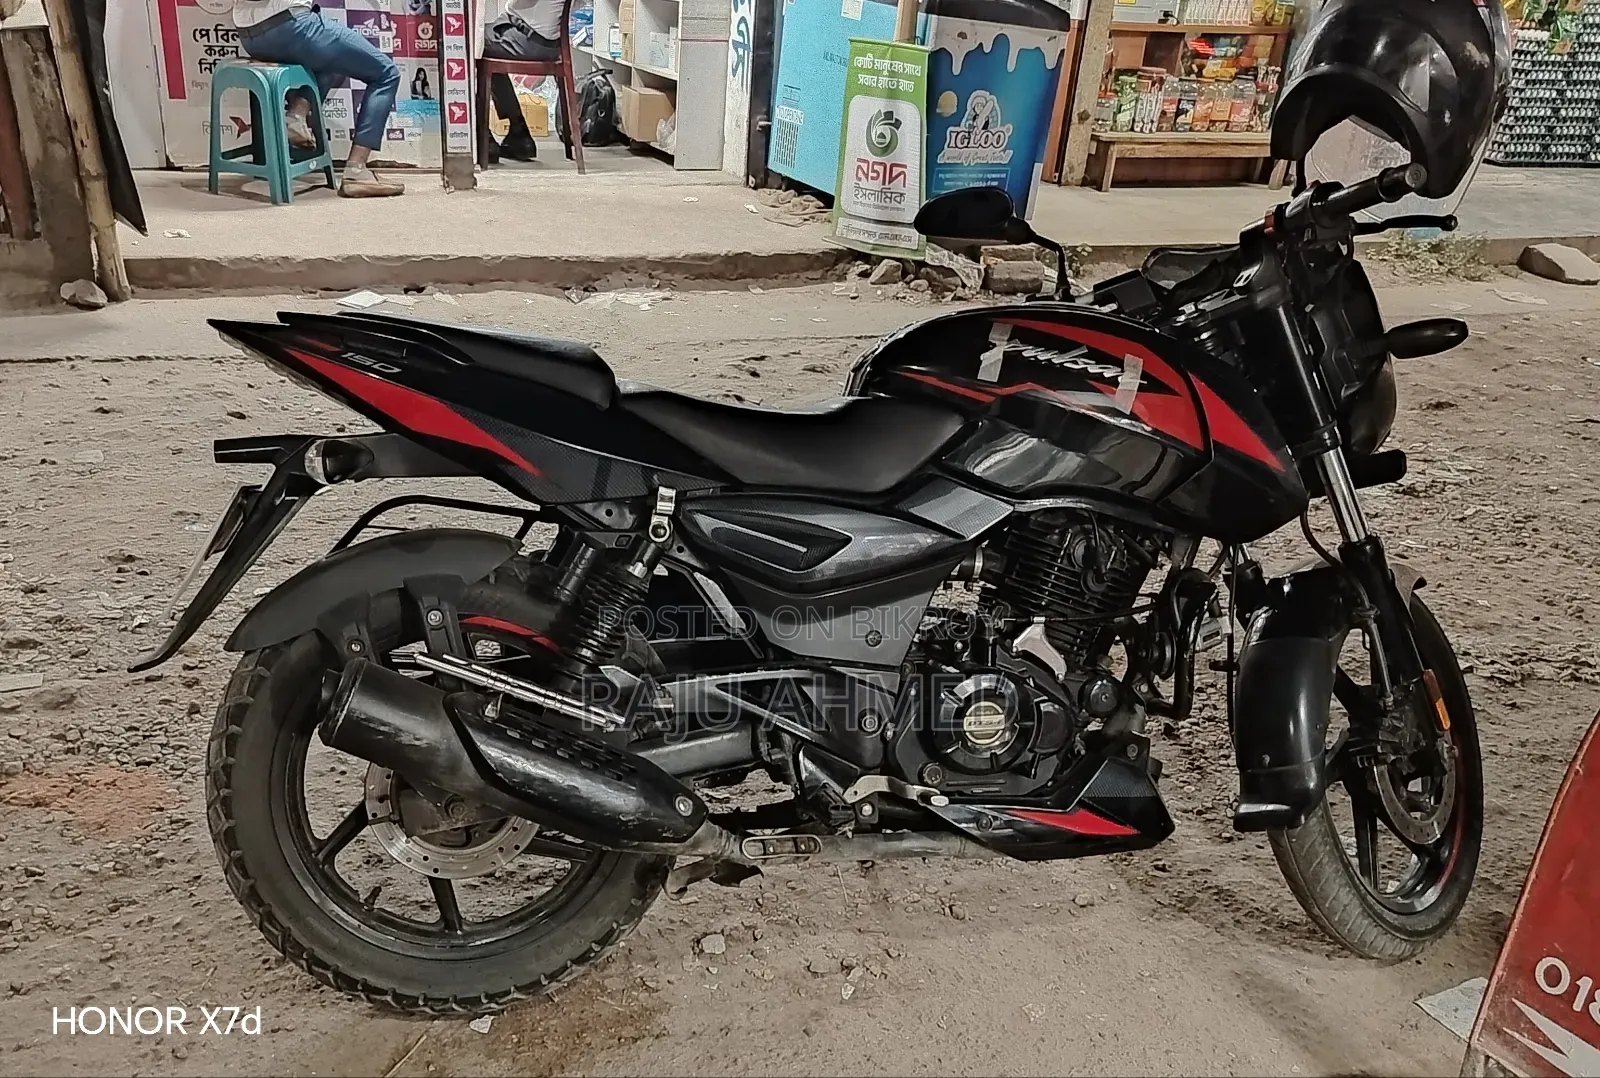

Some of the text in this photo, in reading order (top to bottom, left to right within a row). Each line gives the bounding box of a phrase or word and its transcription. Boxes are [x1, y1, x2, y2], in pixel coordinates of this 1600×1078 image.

[193, 29, 211, 42] পে
[415, 39, 437, 50] নগদ
[203, 45, 239, 58] করুন
[854, 53, 873, 69] কোটি
[874, 59, 903, 75] মানুষের
[904, 63, 921, 77] সাথে
[858, 74, 914, 92] সবার হাতে হাতে
[947, 130, 1006, 149] IGLOO
[856, 158, 907, 188] নগদ
[853, 182, 906, 205] ইসলামিক
[341, 352, 402, 373] 150
